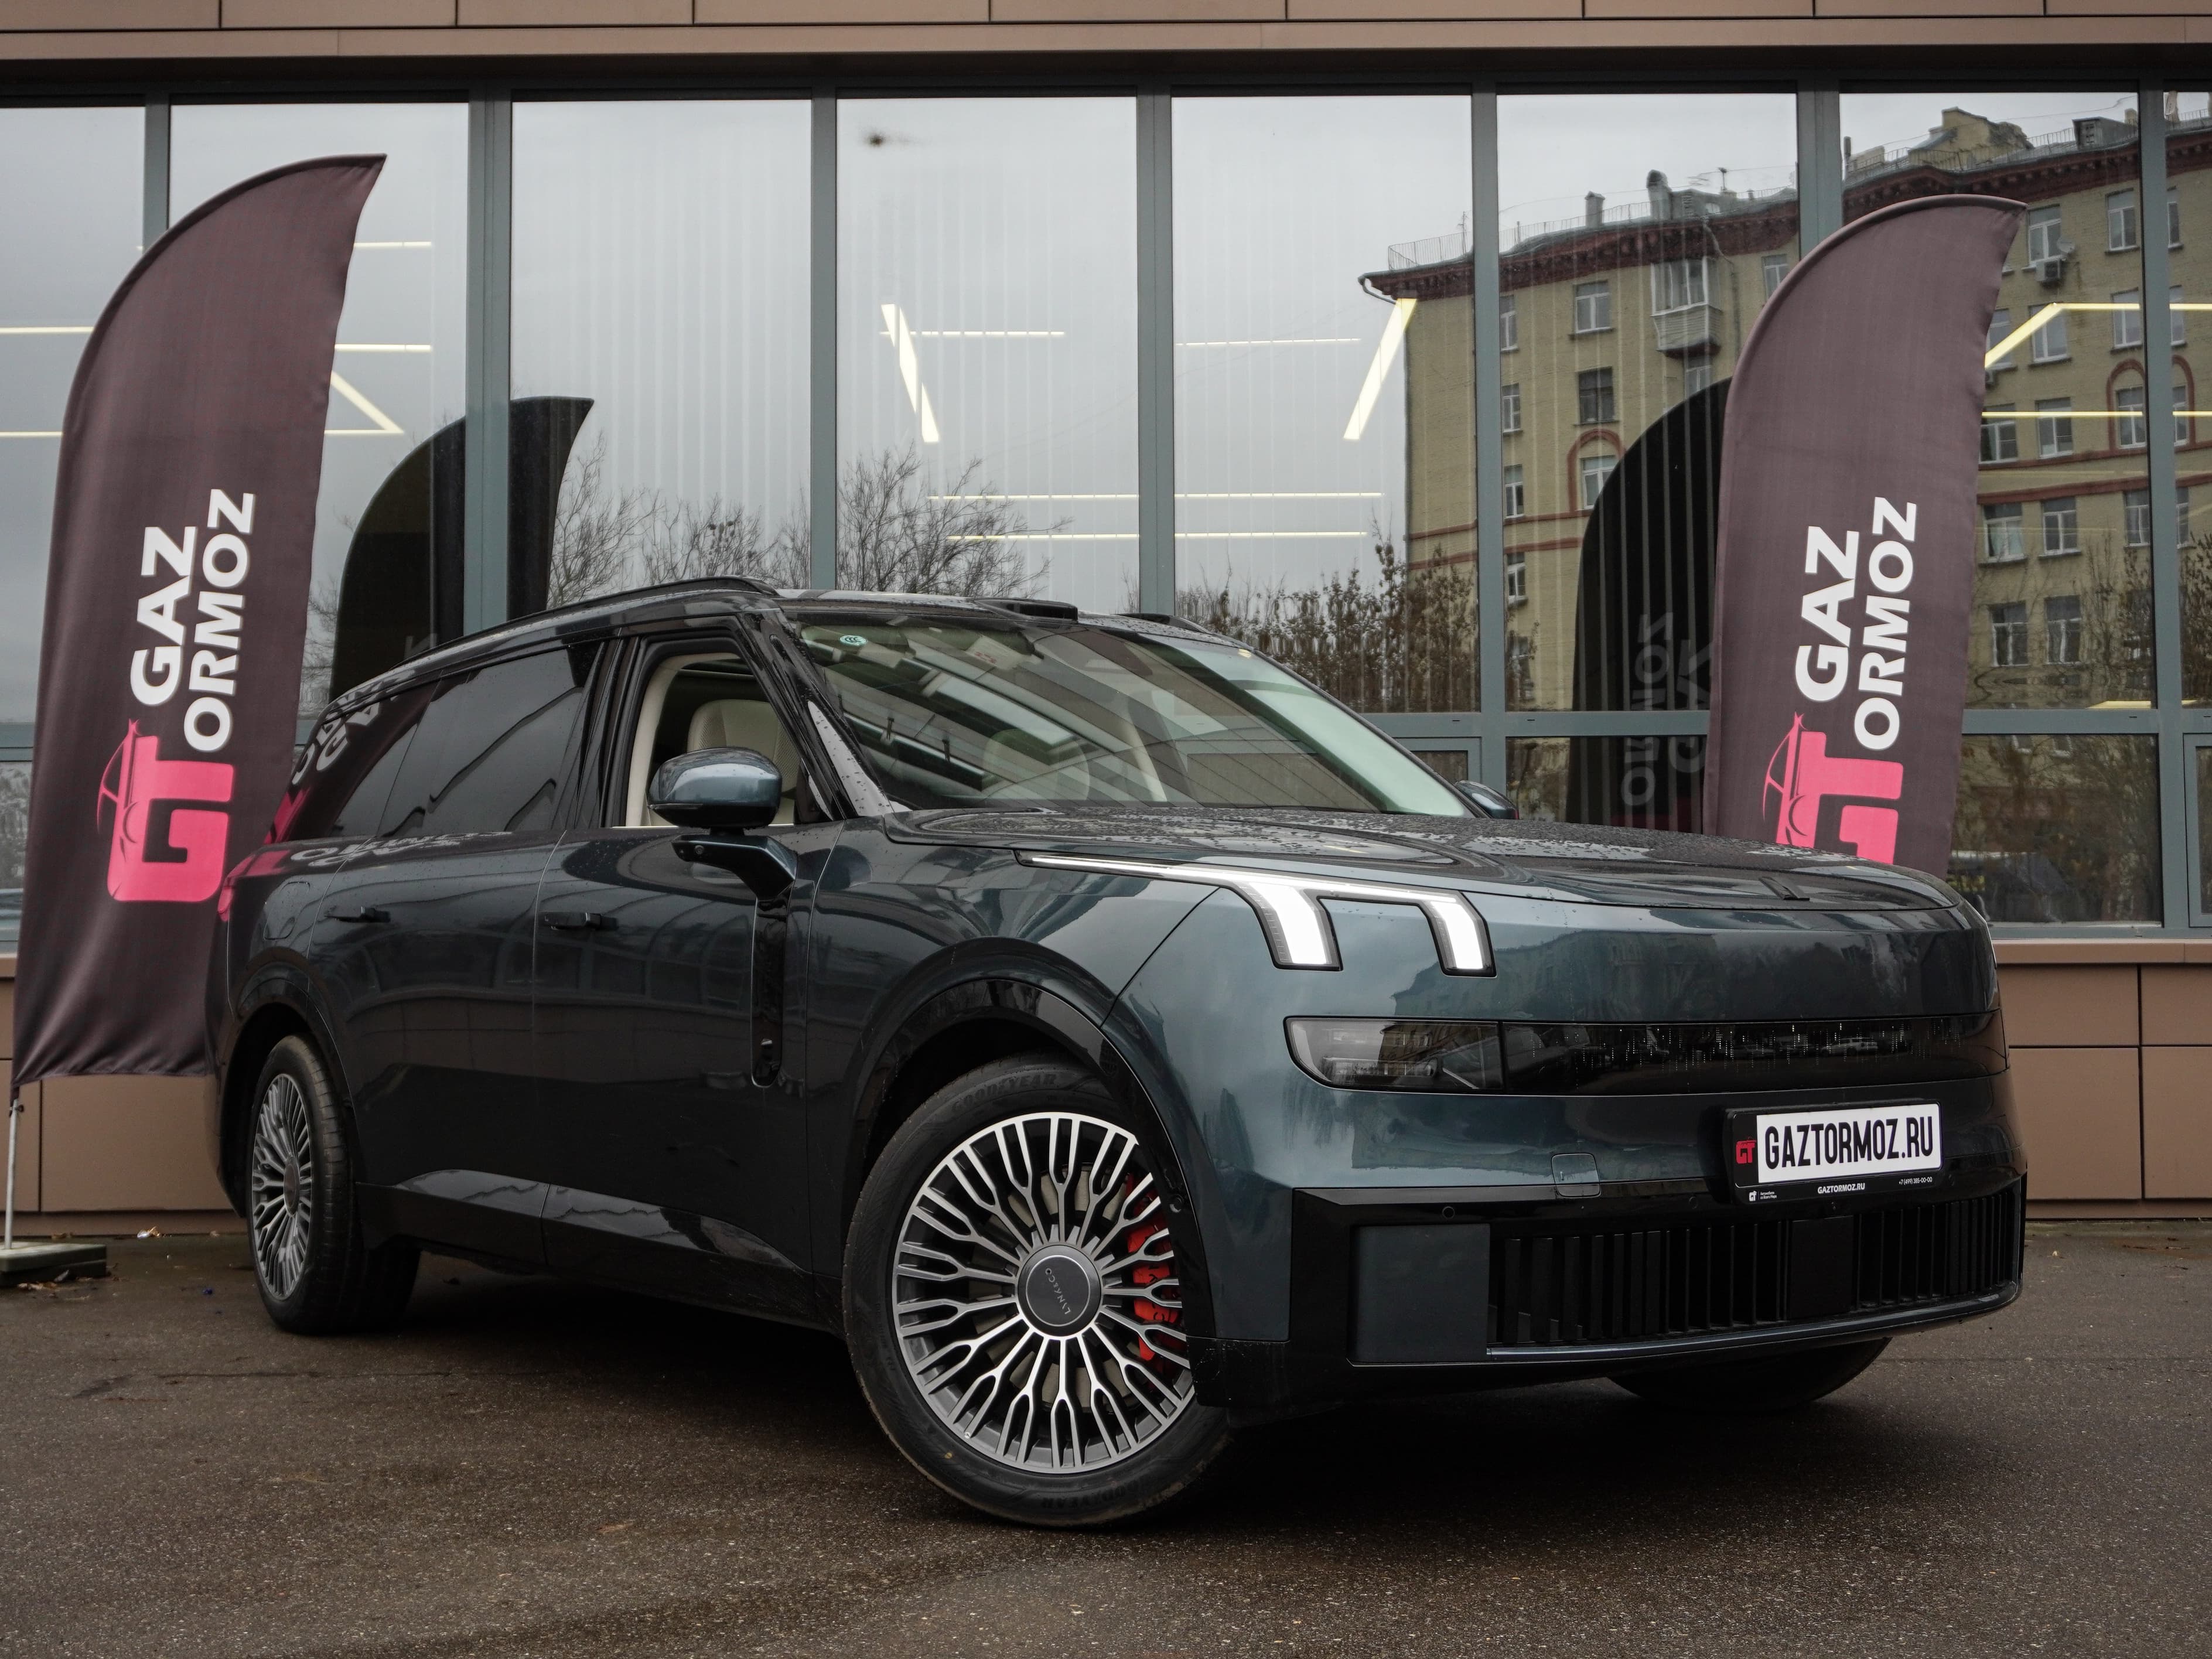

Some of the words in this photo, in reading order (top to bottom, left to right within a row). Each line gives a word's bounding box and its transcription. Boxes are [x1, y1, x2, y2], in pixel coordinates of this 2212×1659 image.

[130, 526, 197, 706] GAZ
[184, 489, 254, 752] ORMOZ
[1794, 525, 1860, 702] GAZ
[1853, 496, 1917, 750] ORMOZ
[1736, 1139, 1756, 1164] GT
[1764, 1116, 1934, 1170] GAZTORMOZ.RU
[1817, 1182, 1865, 1194] GAZTORMOZ.RU
